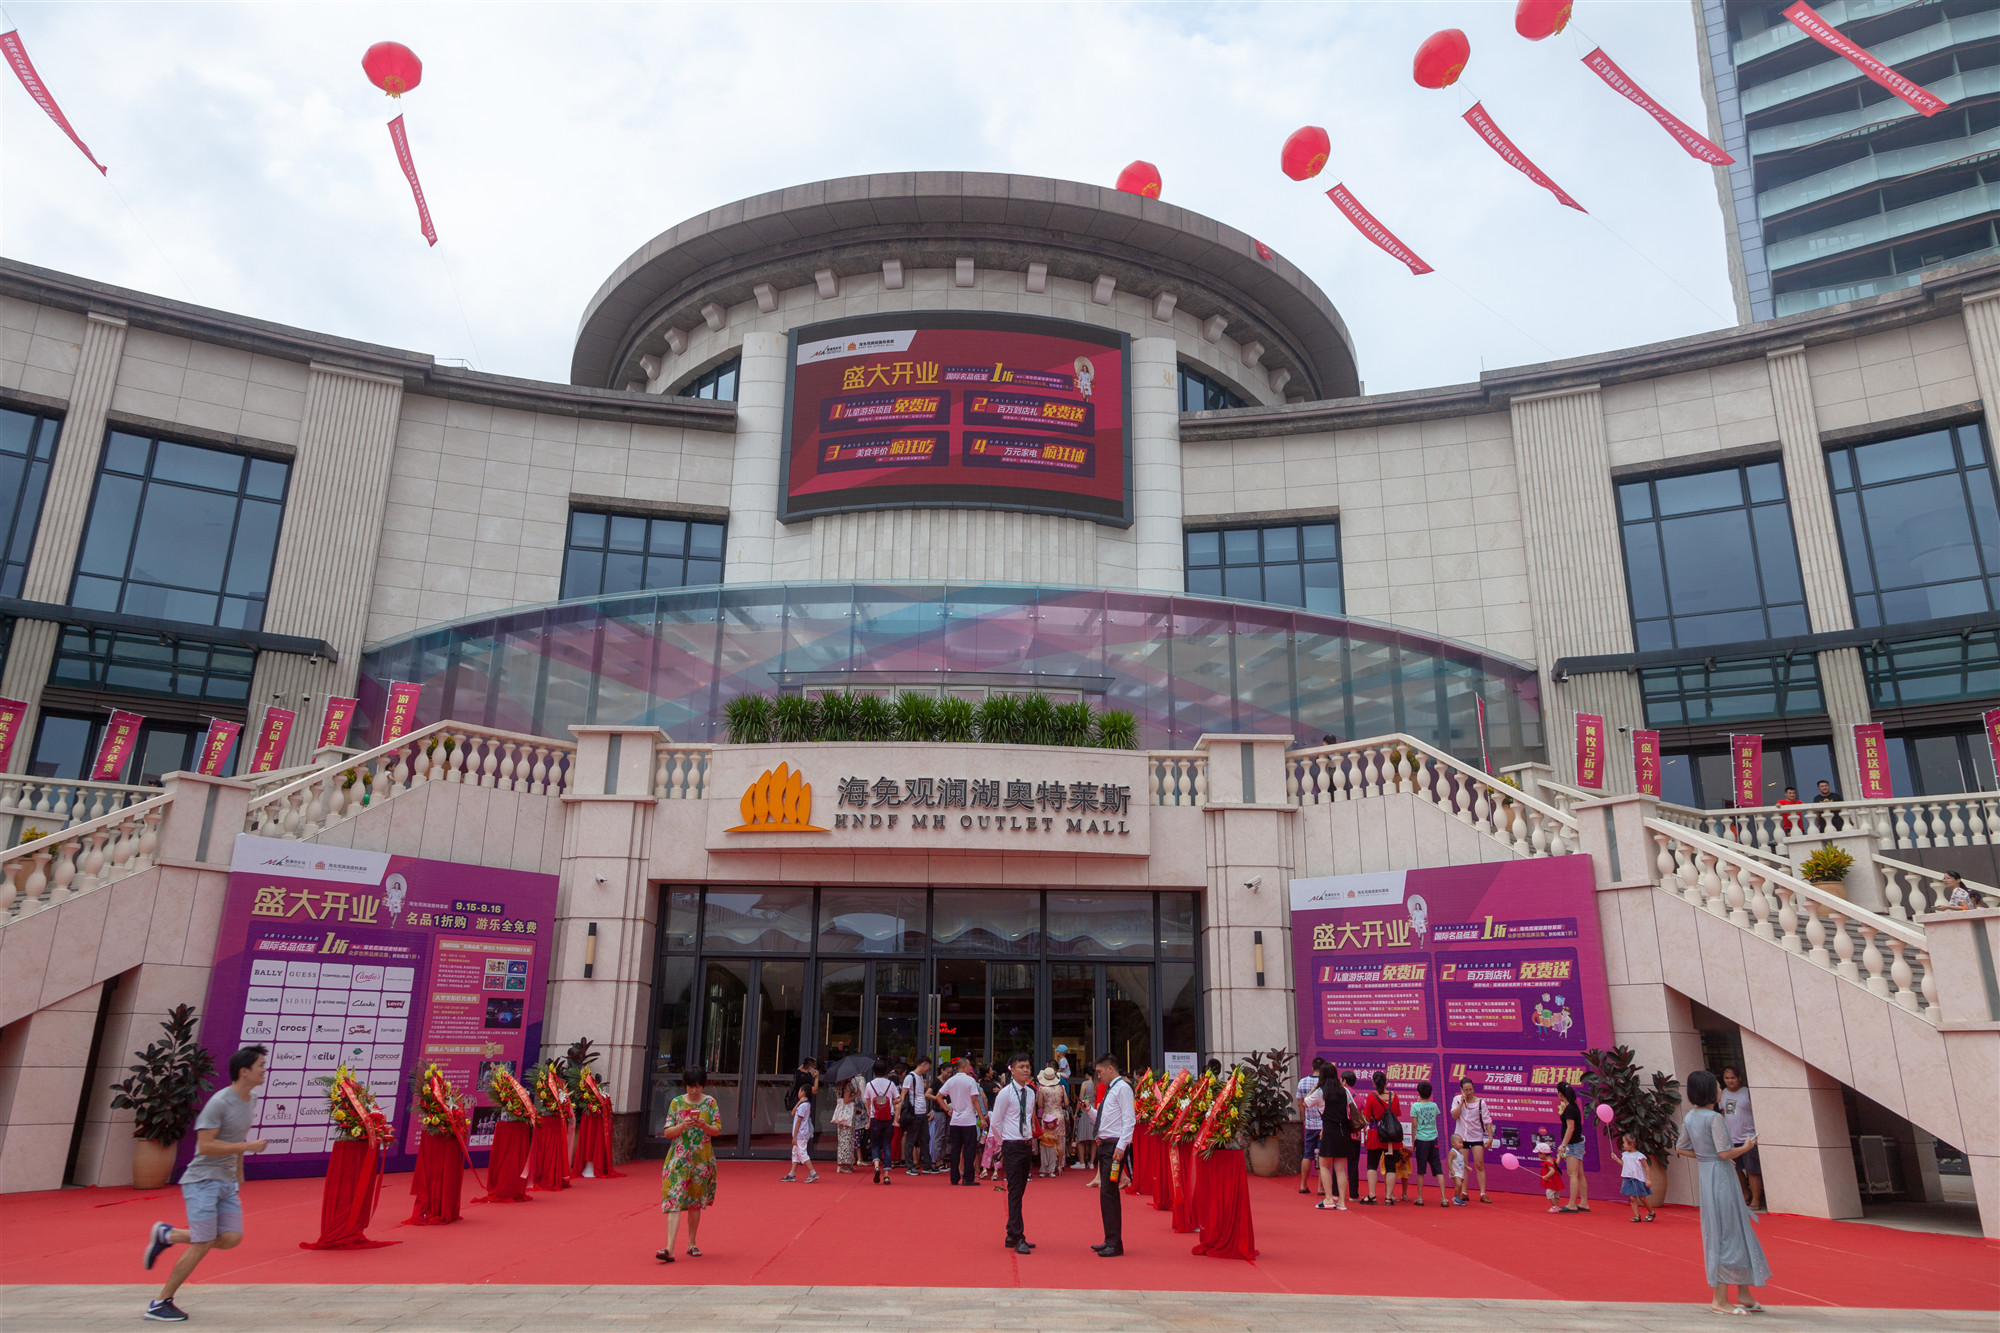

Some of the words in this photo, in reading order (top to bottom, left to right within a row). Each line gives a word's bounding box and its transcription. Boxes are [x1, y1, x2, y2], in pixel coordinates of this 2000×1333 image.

[843, 361, 939, 390] 盛大开业
[946, 372, 988, 381] 国际名品低至
[990, 362, 1014, 383] 1折
[833, 404, 842, 418] 1
[844, 405, 892, 417] 儿童游乐项目
[894, 398, 939, 413] 免费玩
[974, 397, 988, 411] 2
[997, 404, 1038, 416] 百万到店礼
[1042, 403, 1085, 420] 免费送
[826, 445, 840, 460] 3
[855, 447, 888, 457] 美食半价
[889, 439, 934, 454] 疯狂吃
[974, 440, 986, 453] 4
[1004, 447, 1037, 457] 万元家电
[1042, 446, 1085, 463] 疯狂抽
[103, 725, 130, 773] 游乐全免费
[259, 721, 283, 771] 名品1折购
[1584, 726, 1596, 779] 餐饮5折享
[1641, 743, 1653, 794] 盛大开业
[1865, 737, 1882, 790] 到店送豪礼
[1742, 748, 1752, 799] 游乐全免费
[837, 776, 1131, 815] 海免观澜湖奥特莱斯
[835, 814, 898, 828] HNDF
[912, 815, 946, 828] MH
[961, 815, 1053, 830] OUTLET
[1067, 818, 1130, 834] MALL
[252, 886, 380, 924] 盛大开业
[456, 902, 501, 913] 9.15-9.16
[406, 912, 467, 929] 名品1折购
[475, 917, 537, 934] 游乐全免费
[1434, 931, 1478, 940] 国际名品低至
[1481, 915, 1507, 940] 1折
[259, 940, 316, 952] 国际名品低至
[318, 932, 350, 954] 1折
[1313, 919, 1411, 950] 盛大开业
[254, 969, 284, 977] BALLY
[355, 971, 381, 983] Candie's
[1322, 966, 1330, 982] 1
[1333, 972, 1380, 982] 儿童游乐项目
[1382, 963, 1426, 980] 免费玩
[1442, 964, 1456, 980] 2
[1467, 970, 1511, 980] 百万到店礼
[1520, 961, 1570, 979] 免费送
[245, 1027, 272, 1035] CHAPS
[318, 1052, 335, 1060] cilu
[1386, 1063, 1431, 1080] 疯狂吃
[1453, 1064, 1466, 1080] 4
[1485, 1073, 1522, 1083] 万元家电
[1532, 1067, 1583, 1085] 疯狂抽
